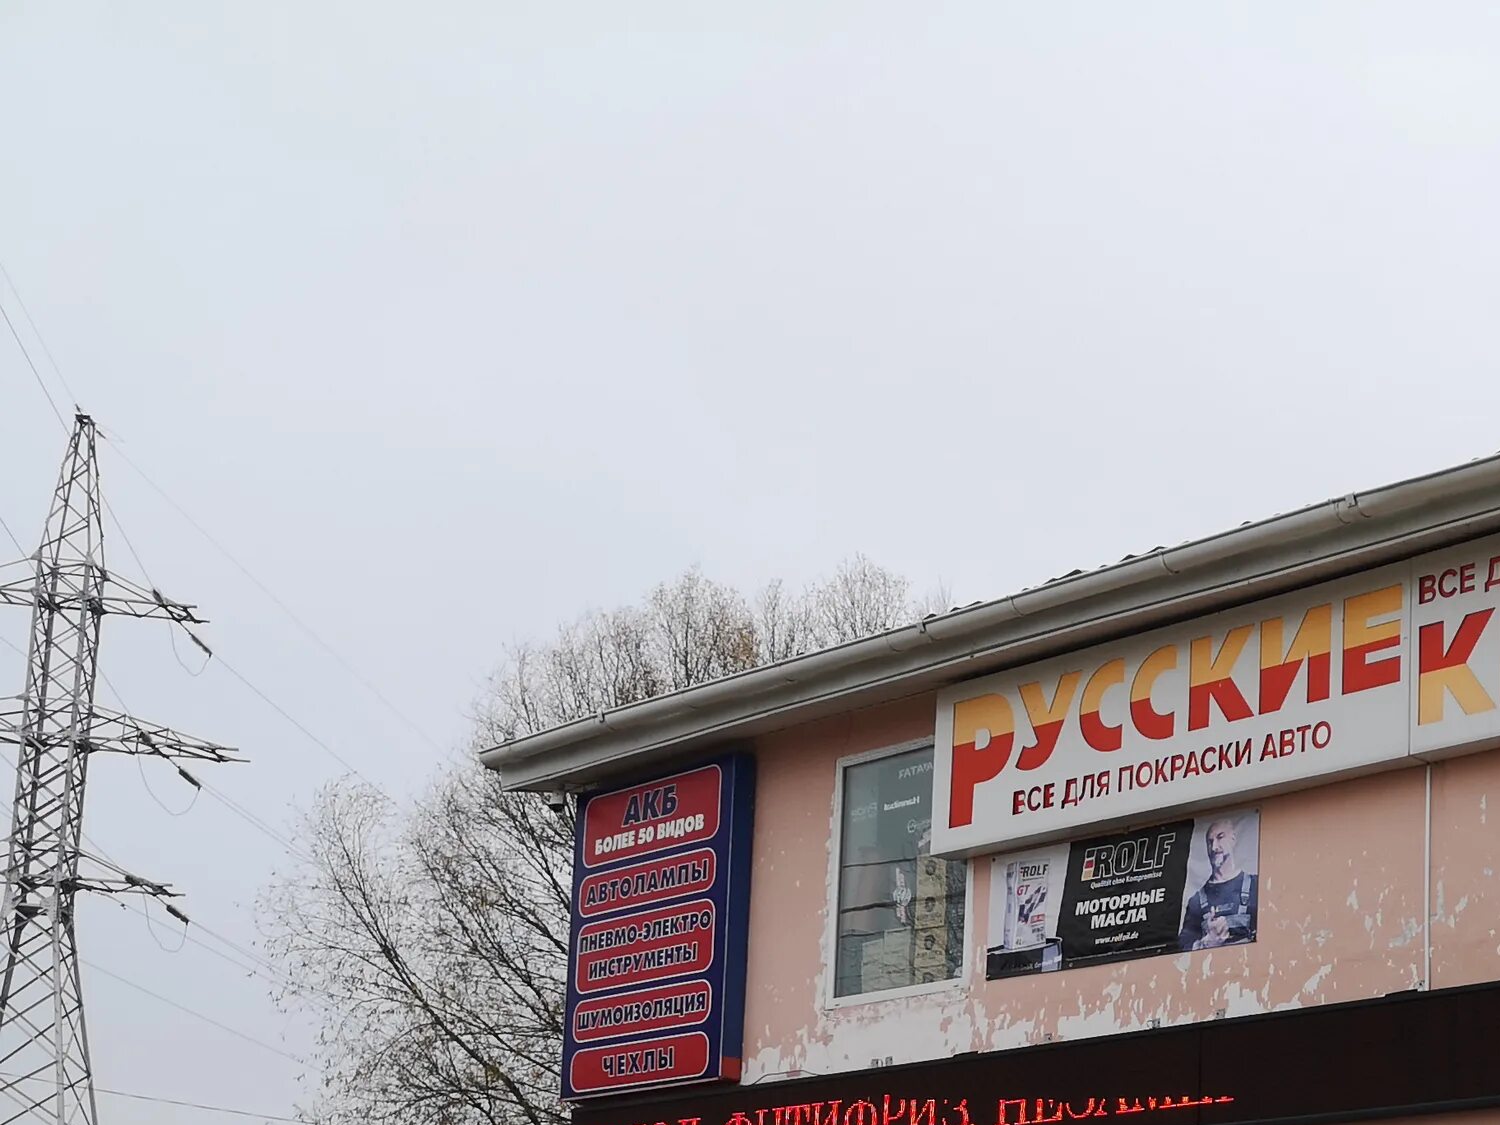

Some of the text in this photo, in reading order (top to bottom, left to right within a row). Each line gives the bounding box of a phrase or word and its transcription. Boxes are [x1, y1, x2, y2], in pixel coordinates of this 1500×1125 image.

[1418, 567, 1475, 604] ВСЕ
[949, 583, 1404, 829] РУССКИЕ
[1012, 720, 1333, 816] ВСЕ ДЛЯ ПОКРАСКИ АВТО
[622, 783, 678, 828] АКБ
[594, 813, 705, 856] БОЛЕЕ 50 ВИДОВ
[1022, 864, 1048, 878] ROLF
[1082, 832, 1176, 881] ROLF
[584, 858, 709, 908] АВТОЛАМПЫ
[1017, 885, 1030, 896] GT
[1075, 888, 1166, 916] МОТОРНЫЕ
[579, 909, 712, 955] ПНЕВМО-ЭЛЕКТРО
[1091, 907, 1147, 929] МАСЛА
[587, 942, 698, 981] ИНСТРУМЕНТЫ
[576, 990, 707, 1030] ШУМОИЗОЛЯЦИЯ
[602, 1047, 675, 1078] ЧЕХЛЫ
